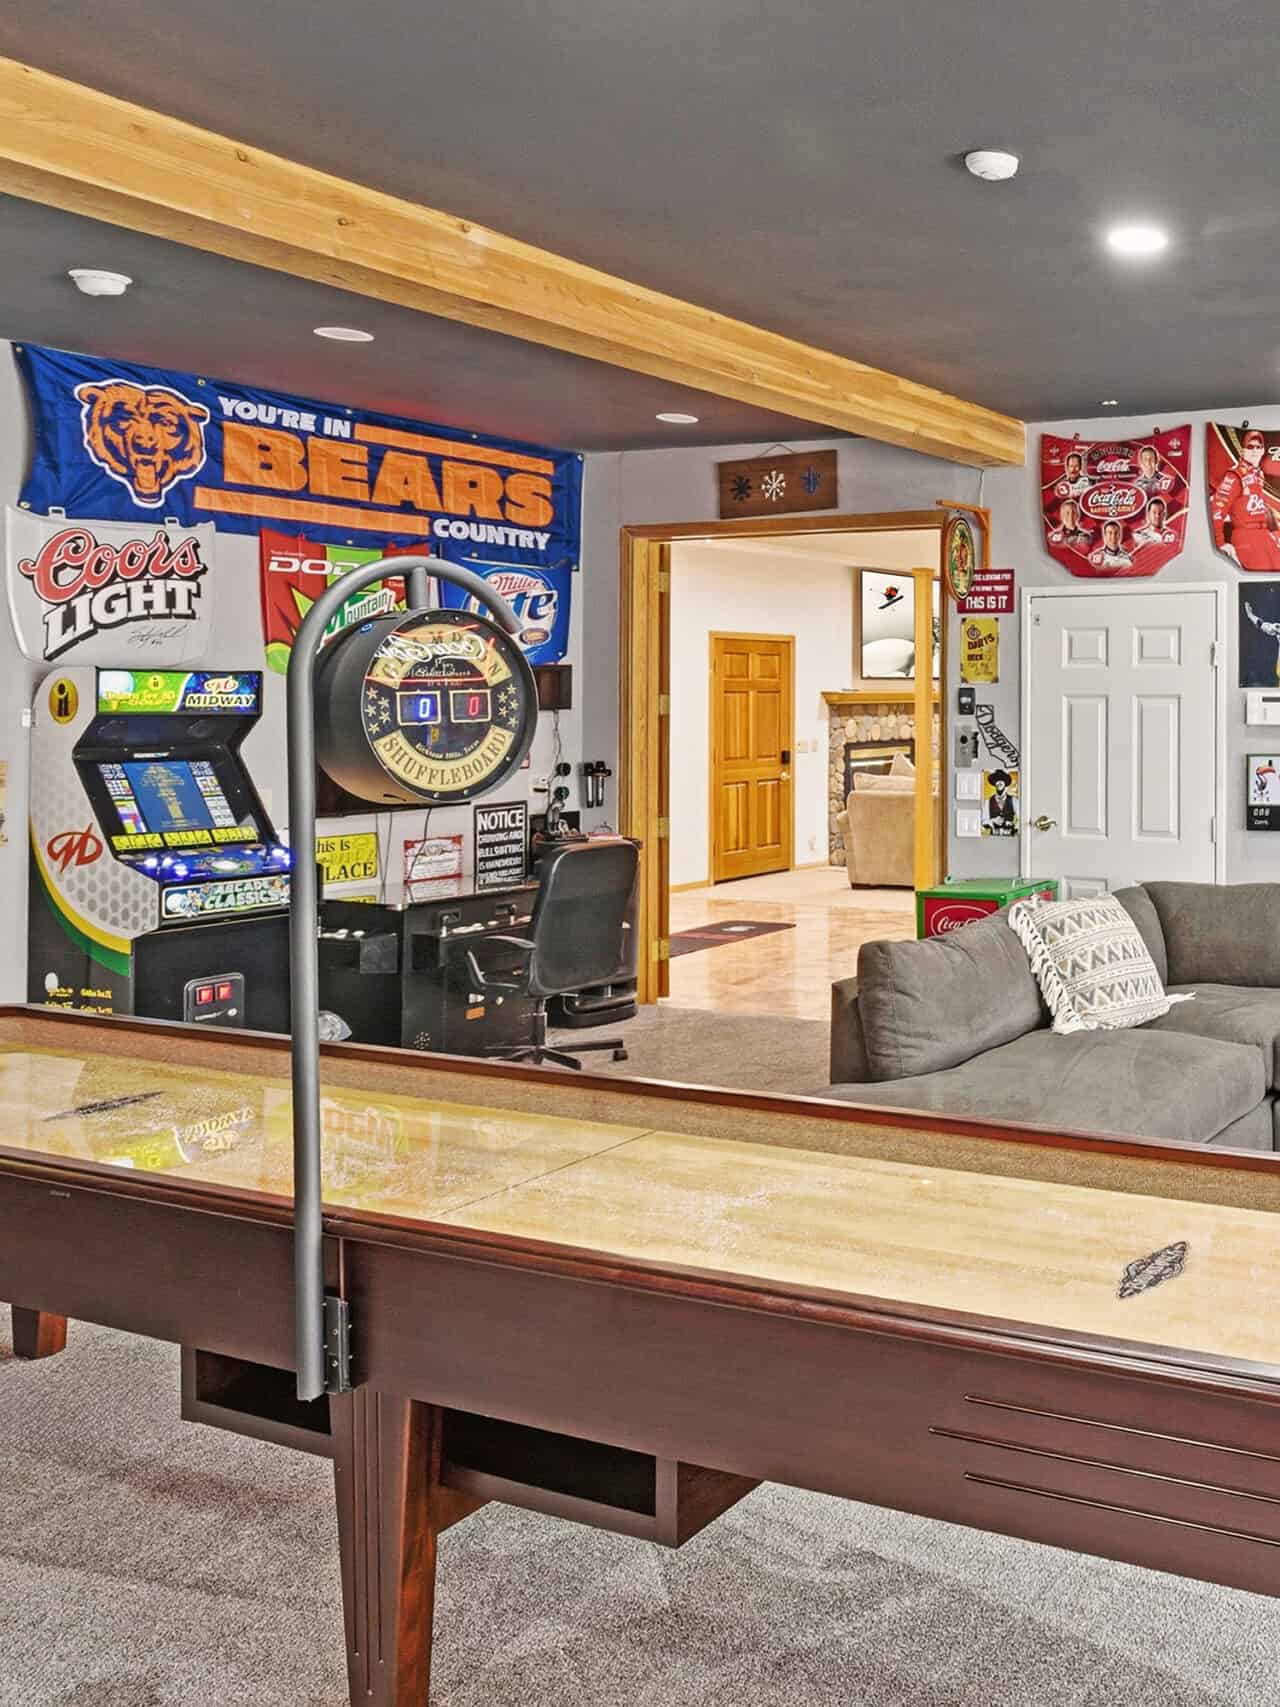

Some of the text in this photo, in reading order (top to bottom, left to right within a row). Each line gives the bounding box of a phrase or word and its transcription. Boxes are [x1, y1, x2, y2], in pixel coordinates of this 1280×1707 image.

[217, 395, 351, 438] YOU'RE IN
[223, 421, 555, 527] BEARS
[1088, 487, 1137, 507] Coca-Cola
[432, 518, 551, 550] COUNTRY
[18, 528, 207, 604] Coors
[268, 556, 361, 576] DOD
[488, 574, 540, 596] Miller
[966, 595, 1008, 609] THIS IS IT
[43, 577, 201, 661] LIGHT
[967, 633, 995, 650] DARTS
[186, 693, 255, 707] MIDWAY
[419, 697, 431, 718] 0
[468, 696, 480, 717] 0
[382, 733, 507, 785] SHUFFLEBOARD
[478, 809, 523, 831] NOTICE
[316, 839, 337, 854] his
[325, 862, 375, 882] LACE
